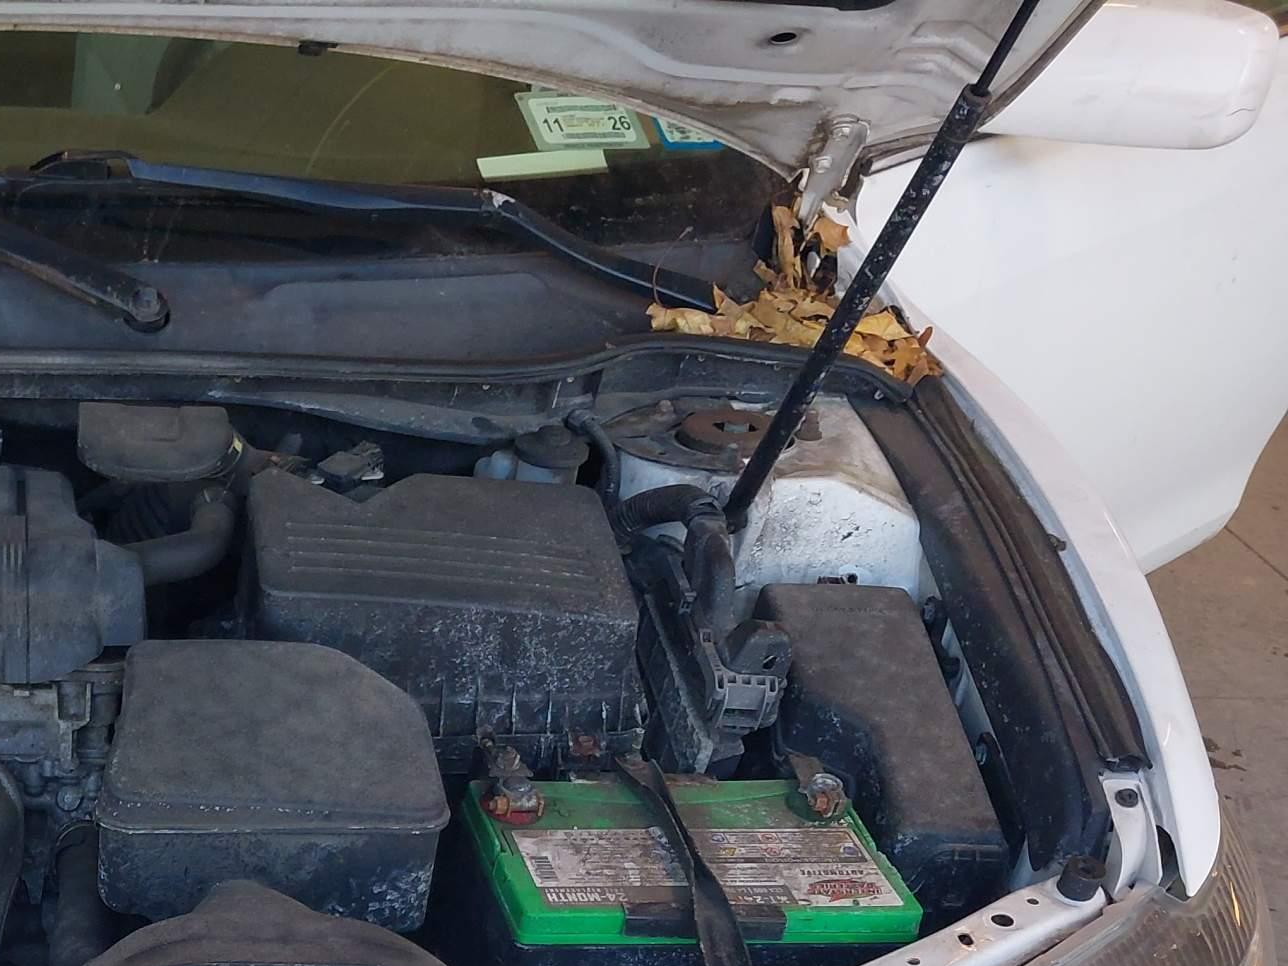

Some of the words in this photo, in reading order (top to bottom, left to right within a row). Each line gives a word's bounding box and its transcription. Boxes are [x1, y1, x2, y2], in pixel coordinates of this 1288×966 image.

[542, 117, 564, 133] 11
[607, 115, 631, 130] 26
[799, 869, 864, 877] AUTOMOTIVE
[545, 892, 629, 903] 24-MONTH
